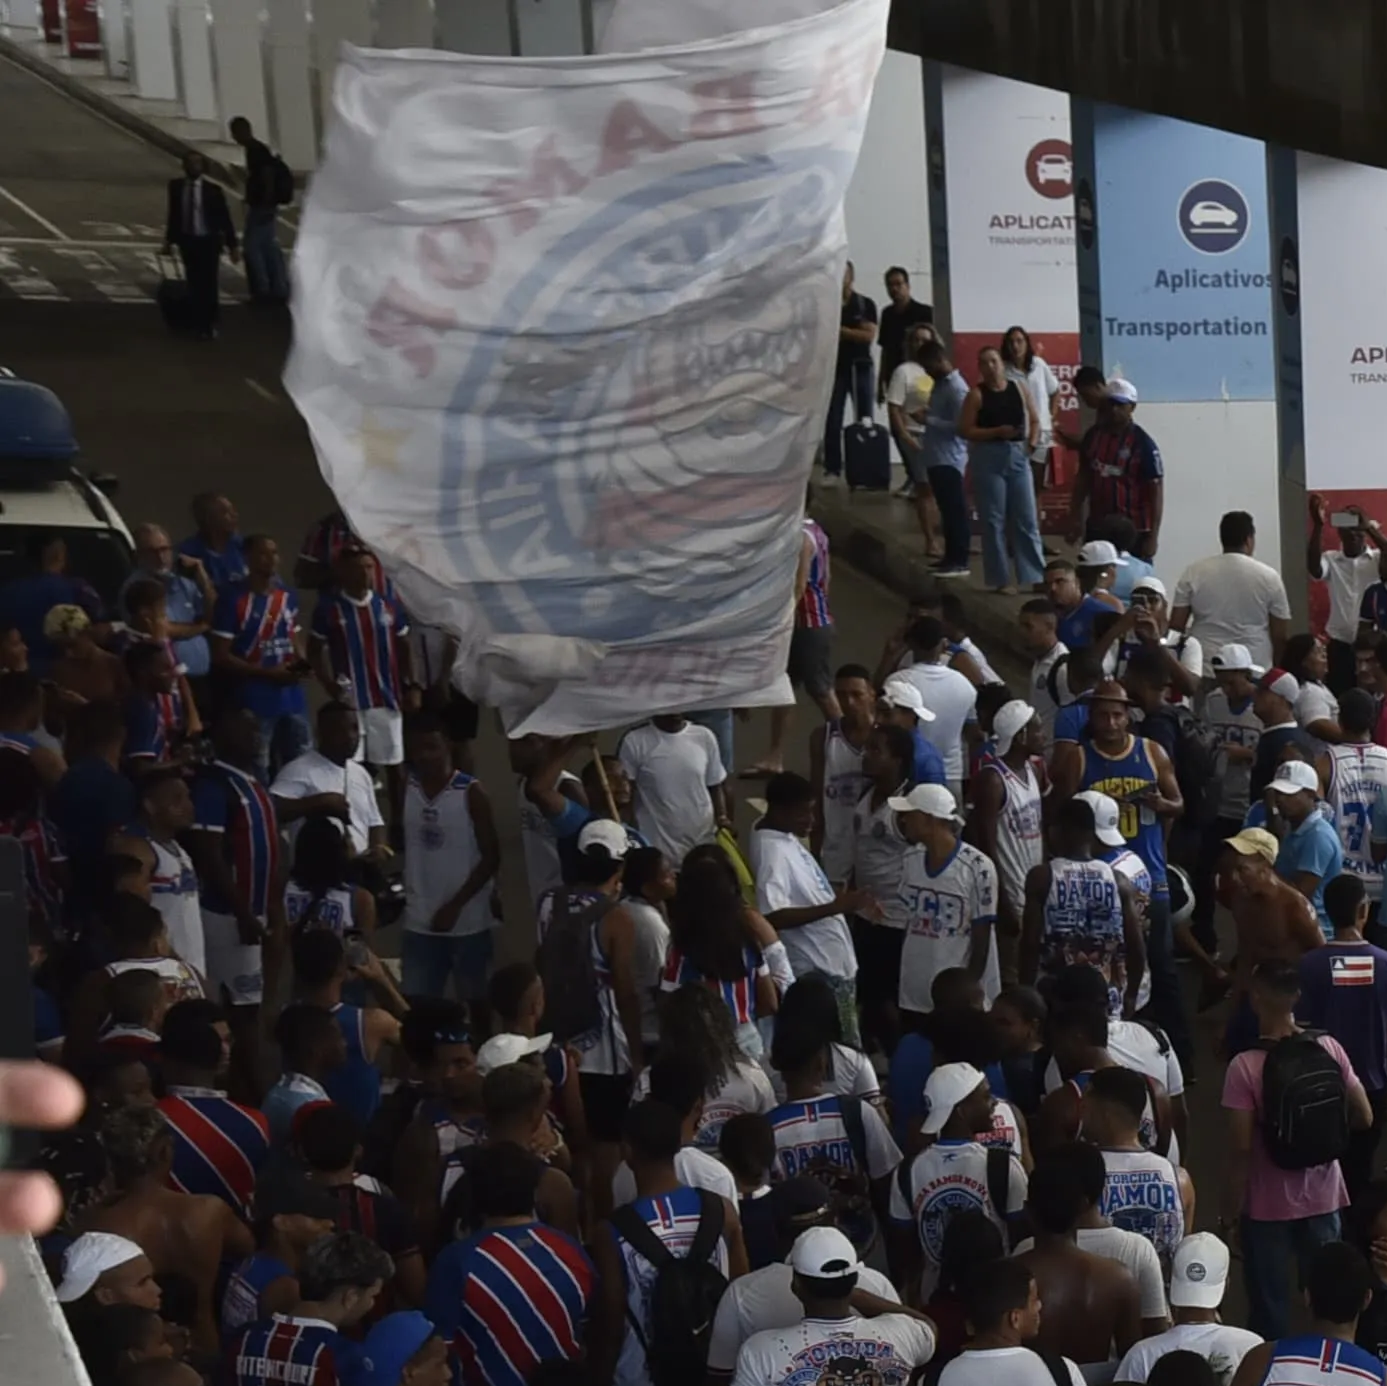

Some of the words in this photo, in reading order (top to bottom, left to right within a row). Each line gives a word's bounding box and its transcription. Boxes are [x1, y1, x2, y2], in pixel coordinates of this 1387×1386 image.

[1104, 316, 1268, 341] Transportation
[1101, 1184, 1177, 1214] AMOR
[793, 1340, 895, 1367] TORCIDA
